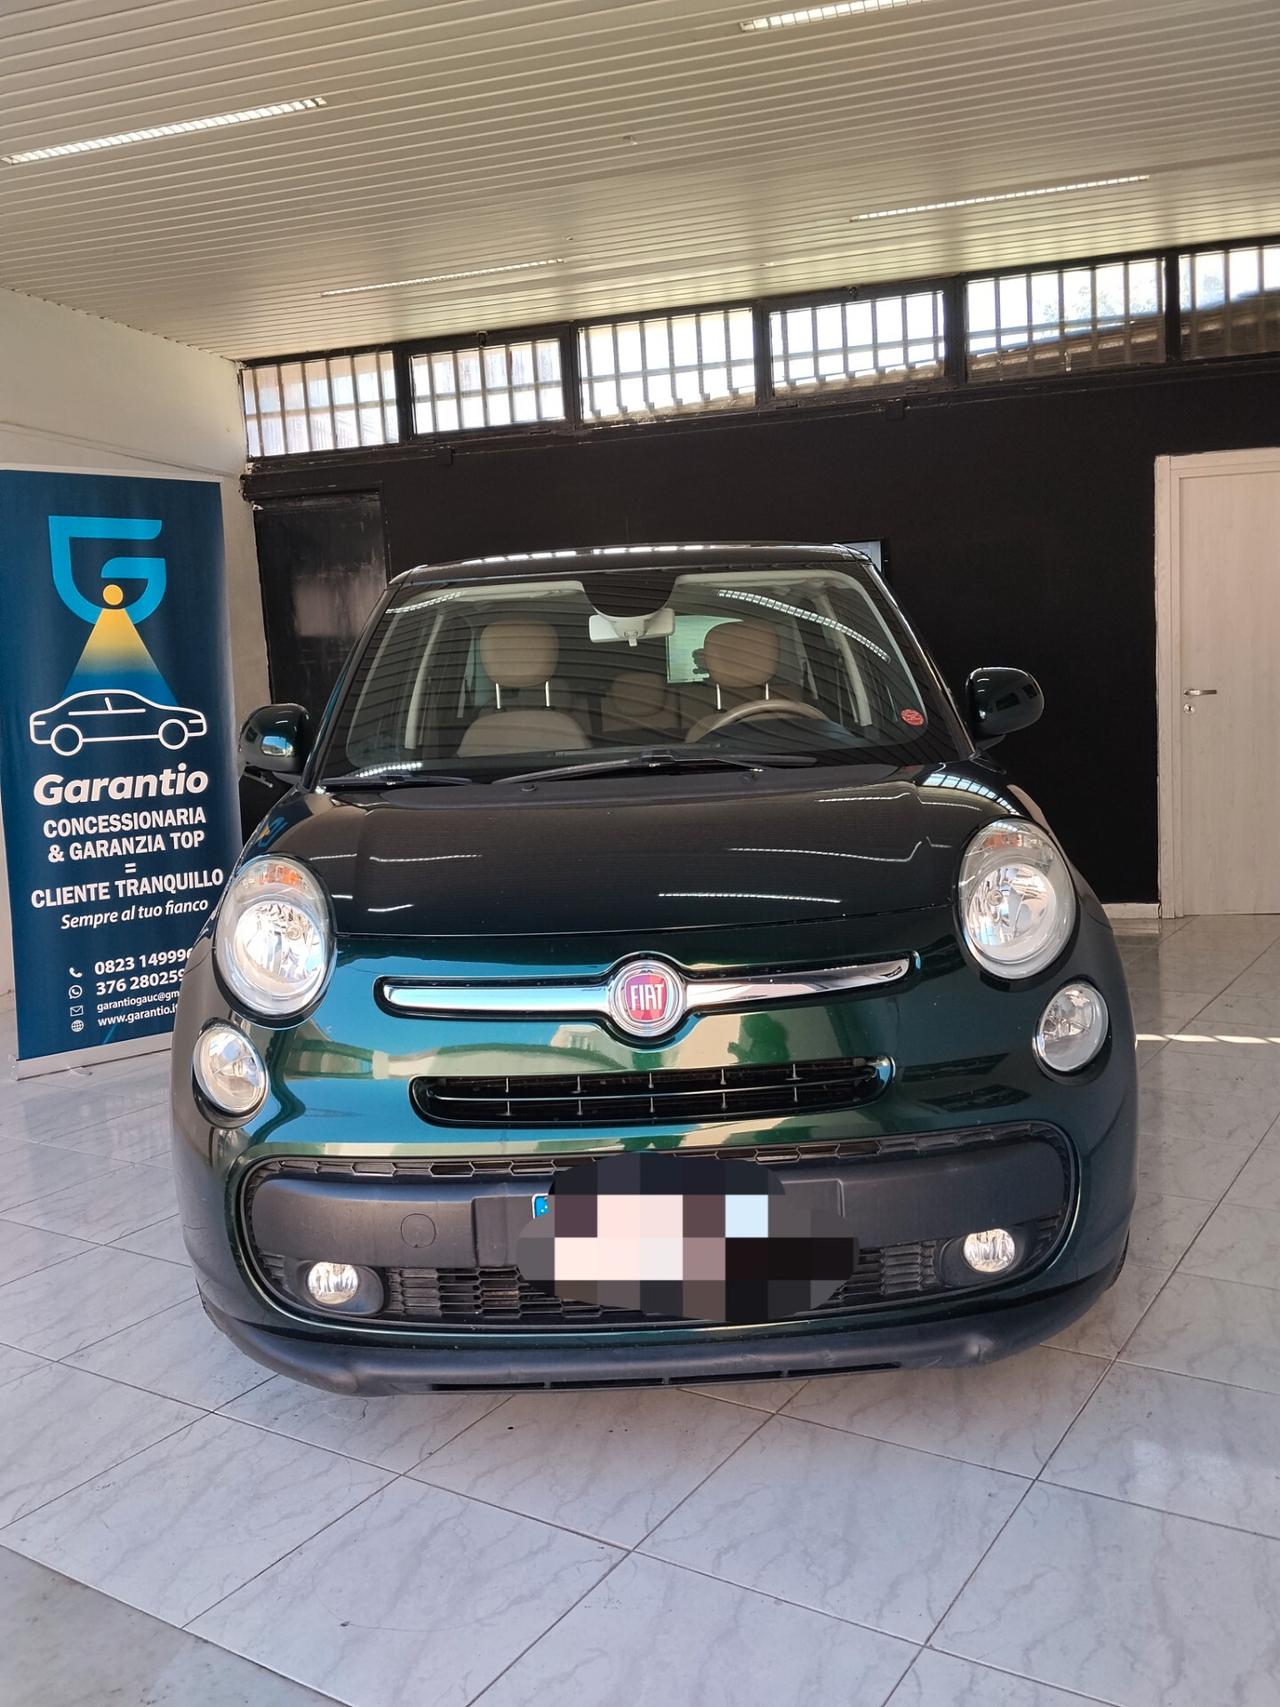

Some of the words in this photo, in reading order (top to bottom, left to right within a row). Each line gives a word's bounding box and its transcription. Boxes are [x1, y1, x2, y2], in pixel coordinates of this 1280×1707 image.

[33, 763, 209, 806] Garantio
[43, 807, 207, 838] CONCESSIONARIA
[48, 844, 65, 863] &
[69, 834, 166, 861] GARANZIA
[170, 830, 205, 850] TOP
[31, 882, 110, 909] CLIENTE
[114, 868, 224, 898] TRANQUILLO
[61, 911, 117, 929] Sempre
[121, 905, 135, 922] al
[138, 902, 163, 918] tuo
[165, 899, 209, 915] fianco
[94, 956, 135, 975] 0823
[96, 978, 127, 996] 376
[630, 983, 664, 1012] FIAT
